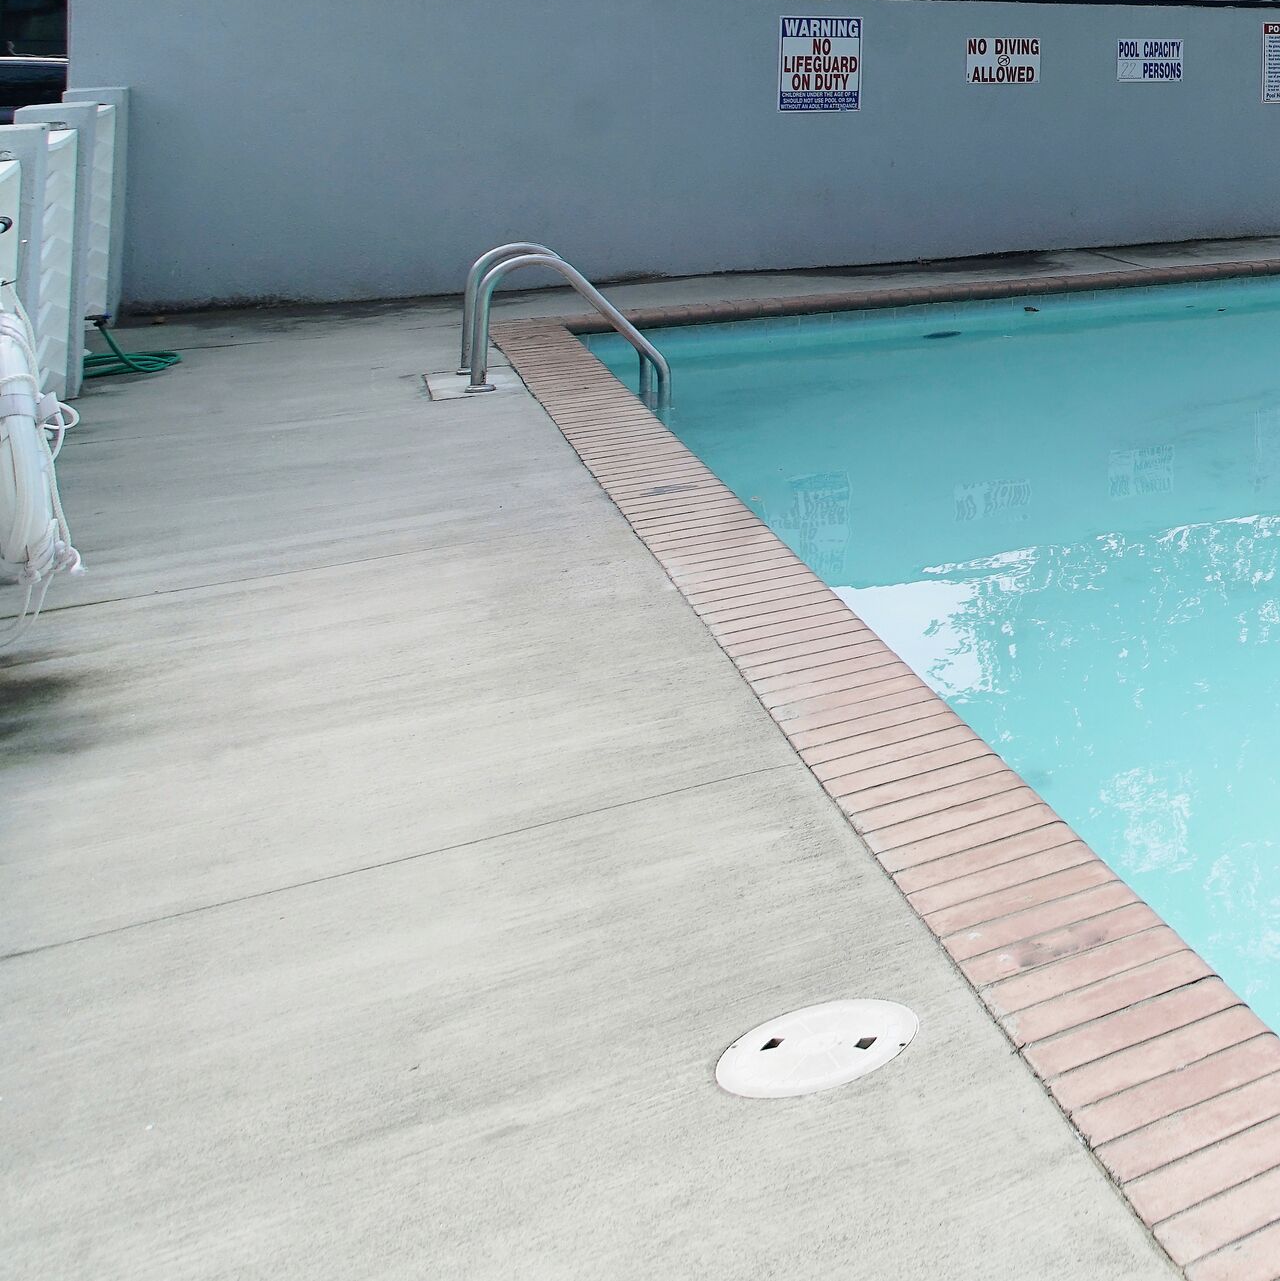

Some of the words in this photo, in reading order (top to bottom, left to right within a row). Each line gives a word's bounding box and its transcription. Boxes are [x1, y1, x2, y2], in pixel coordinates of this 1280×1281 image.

[785, 19, 859, 37] WARNING
[813, 38, 831, 55] NO
[967, 38, 987, 55] NO
[994, 38, 1040, 55] DIVING
[1118, 41, 1140, 58] POOL
[1143, 41, 1181, 58] CAPACITY
[784, 56, 858, 73] LIFEGUARD
[1142, 62, 1182, 79] PERSONS
[791, 73, 811, 90] ON
[815, 73, 850, 90] DUTY
[971, 66, 1035, 82] ALLOWED
